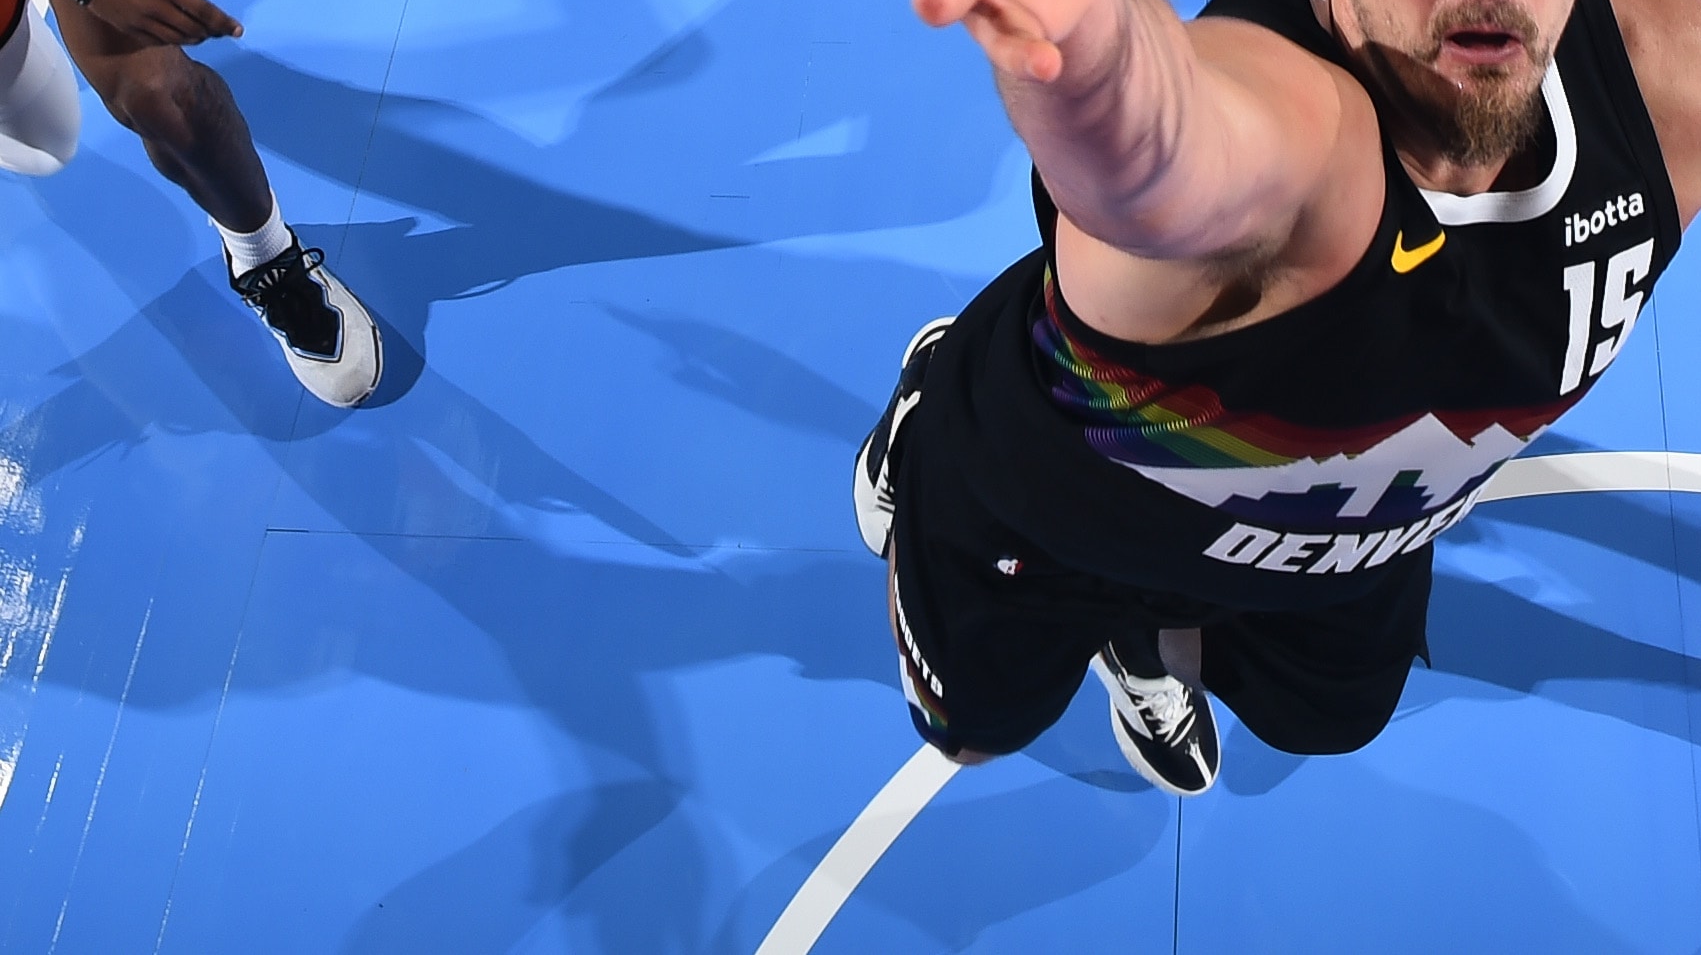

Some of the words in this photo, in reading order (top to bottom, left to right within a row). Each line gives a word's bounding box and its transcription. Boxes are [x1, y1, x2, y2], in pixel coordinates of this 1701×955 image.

[1564, 192, 1645, 247] ibotta
[1559, 237, 1655, 396] 15
[1202, 488, 1482, 574] DENVE
